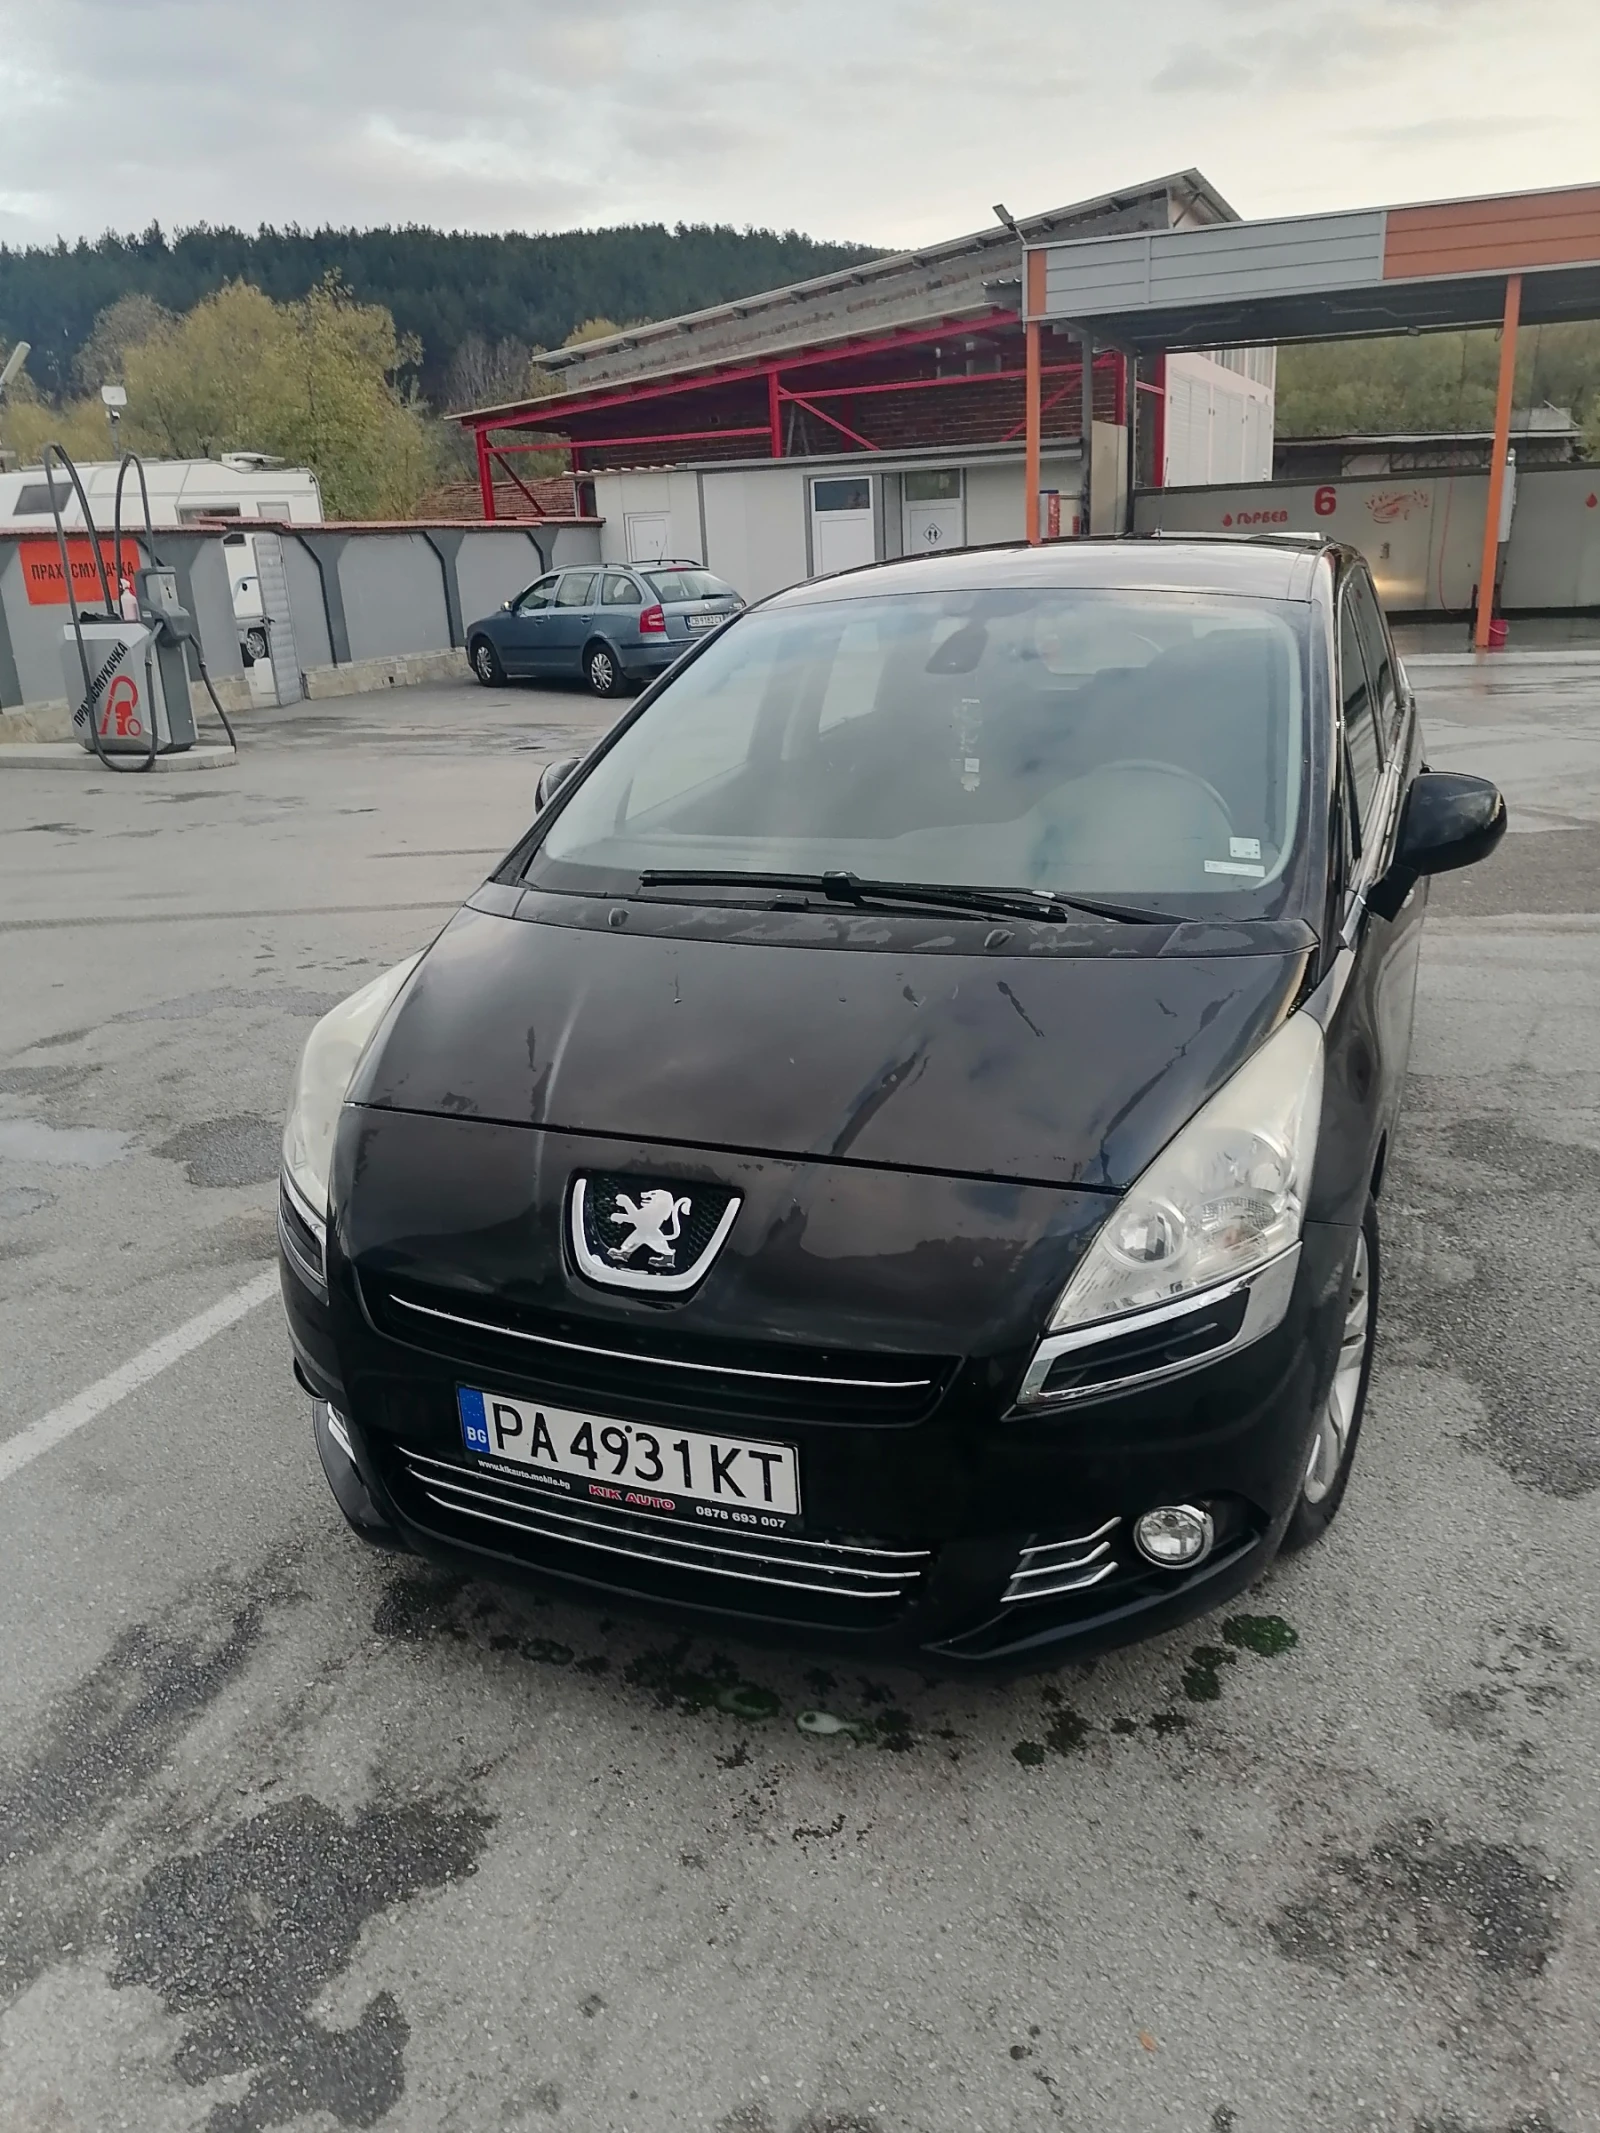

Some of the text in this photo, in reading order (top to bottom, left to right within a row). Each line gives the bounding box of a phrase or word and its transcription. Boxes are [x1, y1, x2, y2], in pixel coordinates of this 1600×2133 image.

[1313, 486, 1337, 516] 6
[30, 561, 135, 581] ПРАХСМУАЧКА
[466, 1426, 488, 1444] BG
[491, 1401, 784, 1503] PA 4931 KT
[477, 1458, 571, 1490] www.kikauto.mobile.bg
[588, 1484, 676, 1511] KIK AUTO
[695, 1505, 787, 1530] 0878 693 007
